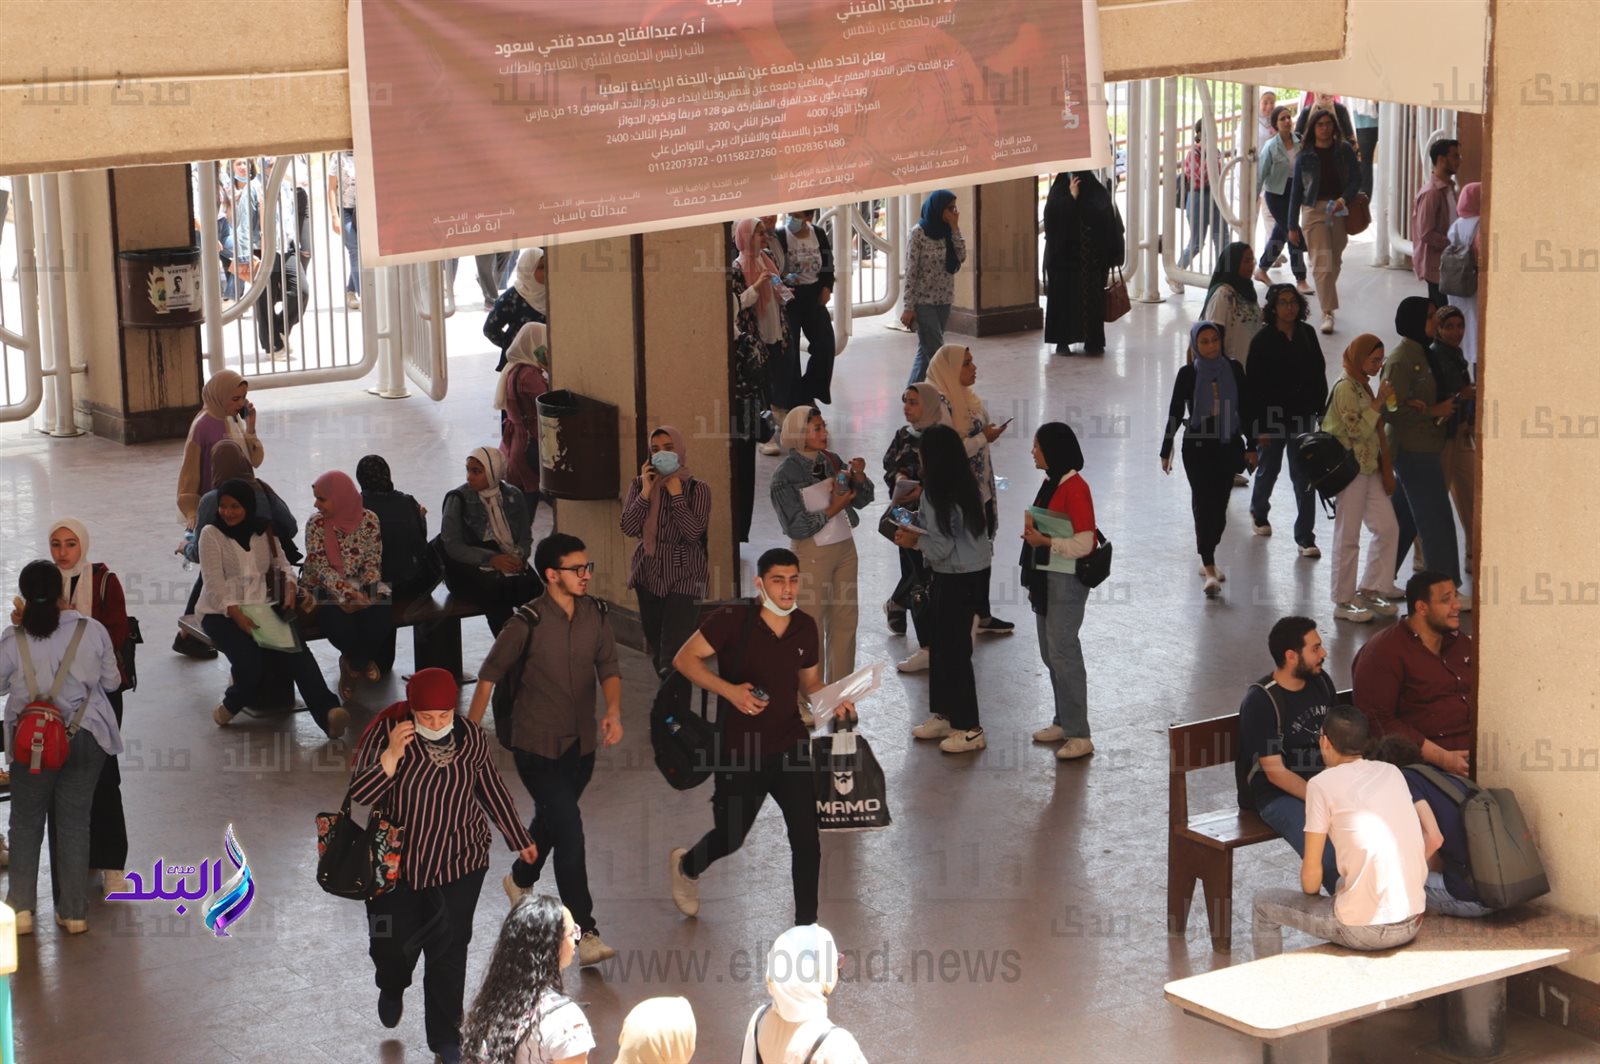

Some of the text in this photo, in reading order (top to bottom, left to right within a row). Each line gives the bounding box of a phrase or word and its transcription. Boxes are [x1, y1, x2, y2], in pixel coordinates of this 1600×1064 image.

[843, 10, 955, 39] رئيس جامعة عين شمس
[577, 33, 615, 47] محمد
[618, 25, 677, 47] عبدالفتاح
[495, 42, 534, 58] سعود
[538, 36, 574, 57] فتحي
[655, 43, 682, 62] رئيس
[614, 48, 653, 64] الجامعة
[836, 52, 860, 66] اتحاد
[862, 51, 886, 65] يعلن
[770, 61, 804, 75] جامعة
[807, 58, 834, 73] طلاب
[748, 66, 768, 80] عين
[599, 81, 627, 97] العليا
[631, 76, 674, 93] الرياضية
[661, 95, 676, 107] من
[803, 94, 817, 103] عدد
[568, 105, 578, 115] 13
[580, 101, 619, 116] الموافق
[704, 105, 720, 116] 128
[721, 106, 735, 116] هو
[737, 99, 775, 113] المشاركة
[807, 107, 829, 118] 4000
[525, 108, 549, 122] مارس
[551, 108, 565, 119] من
[708, 120, 731, 132] 3200
[607, 133, 629, 144] 2400
[671, 139, 704, 155] التواصل
[935, 158, 960, 168] محمد
[788, 172, 855, 192] يوسف عصام
[710, 190, 742, 203] محمد
[553, 208, 586, 225] ياسين
[446, 221, 481, 239] هشام
[816, 799, 881, 815] MAMO
